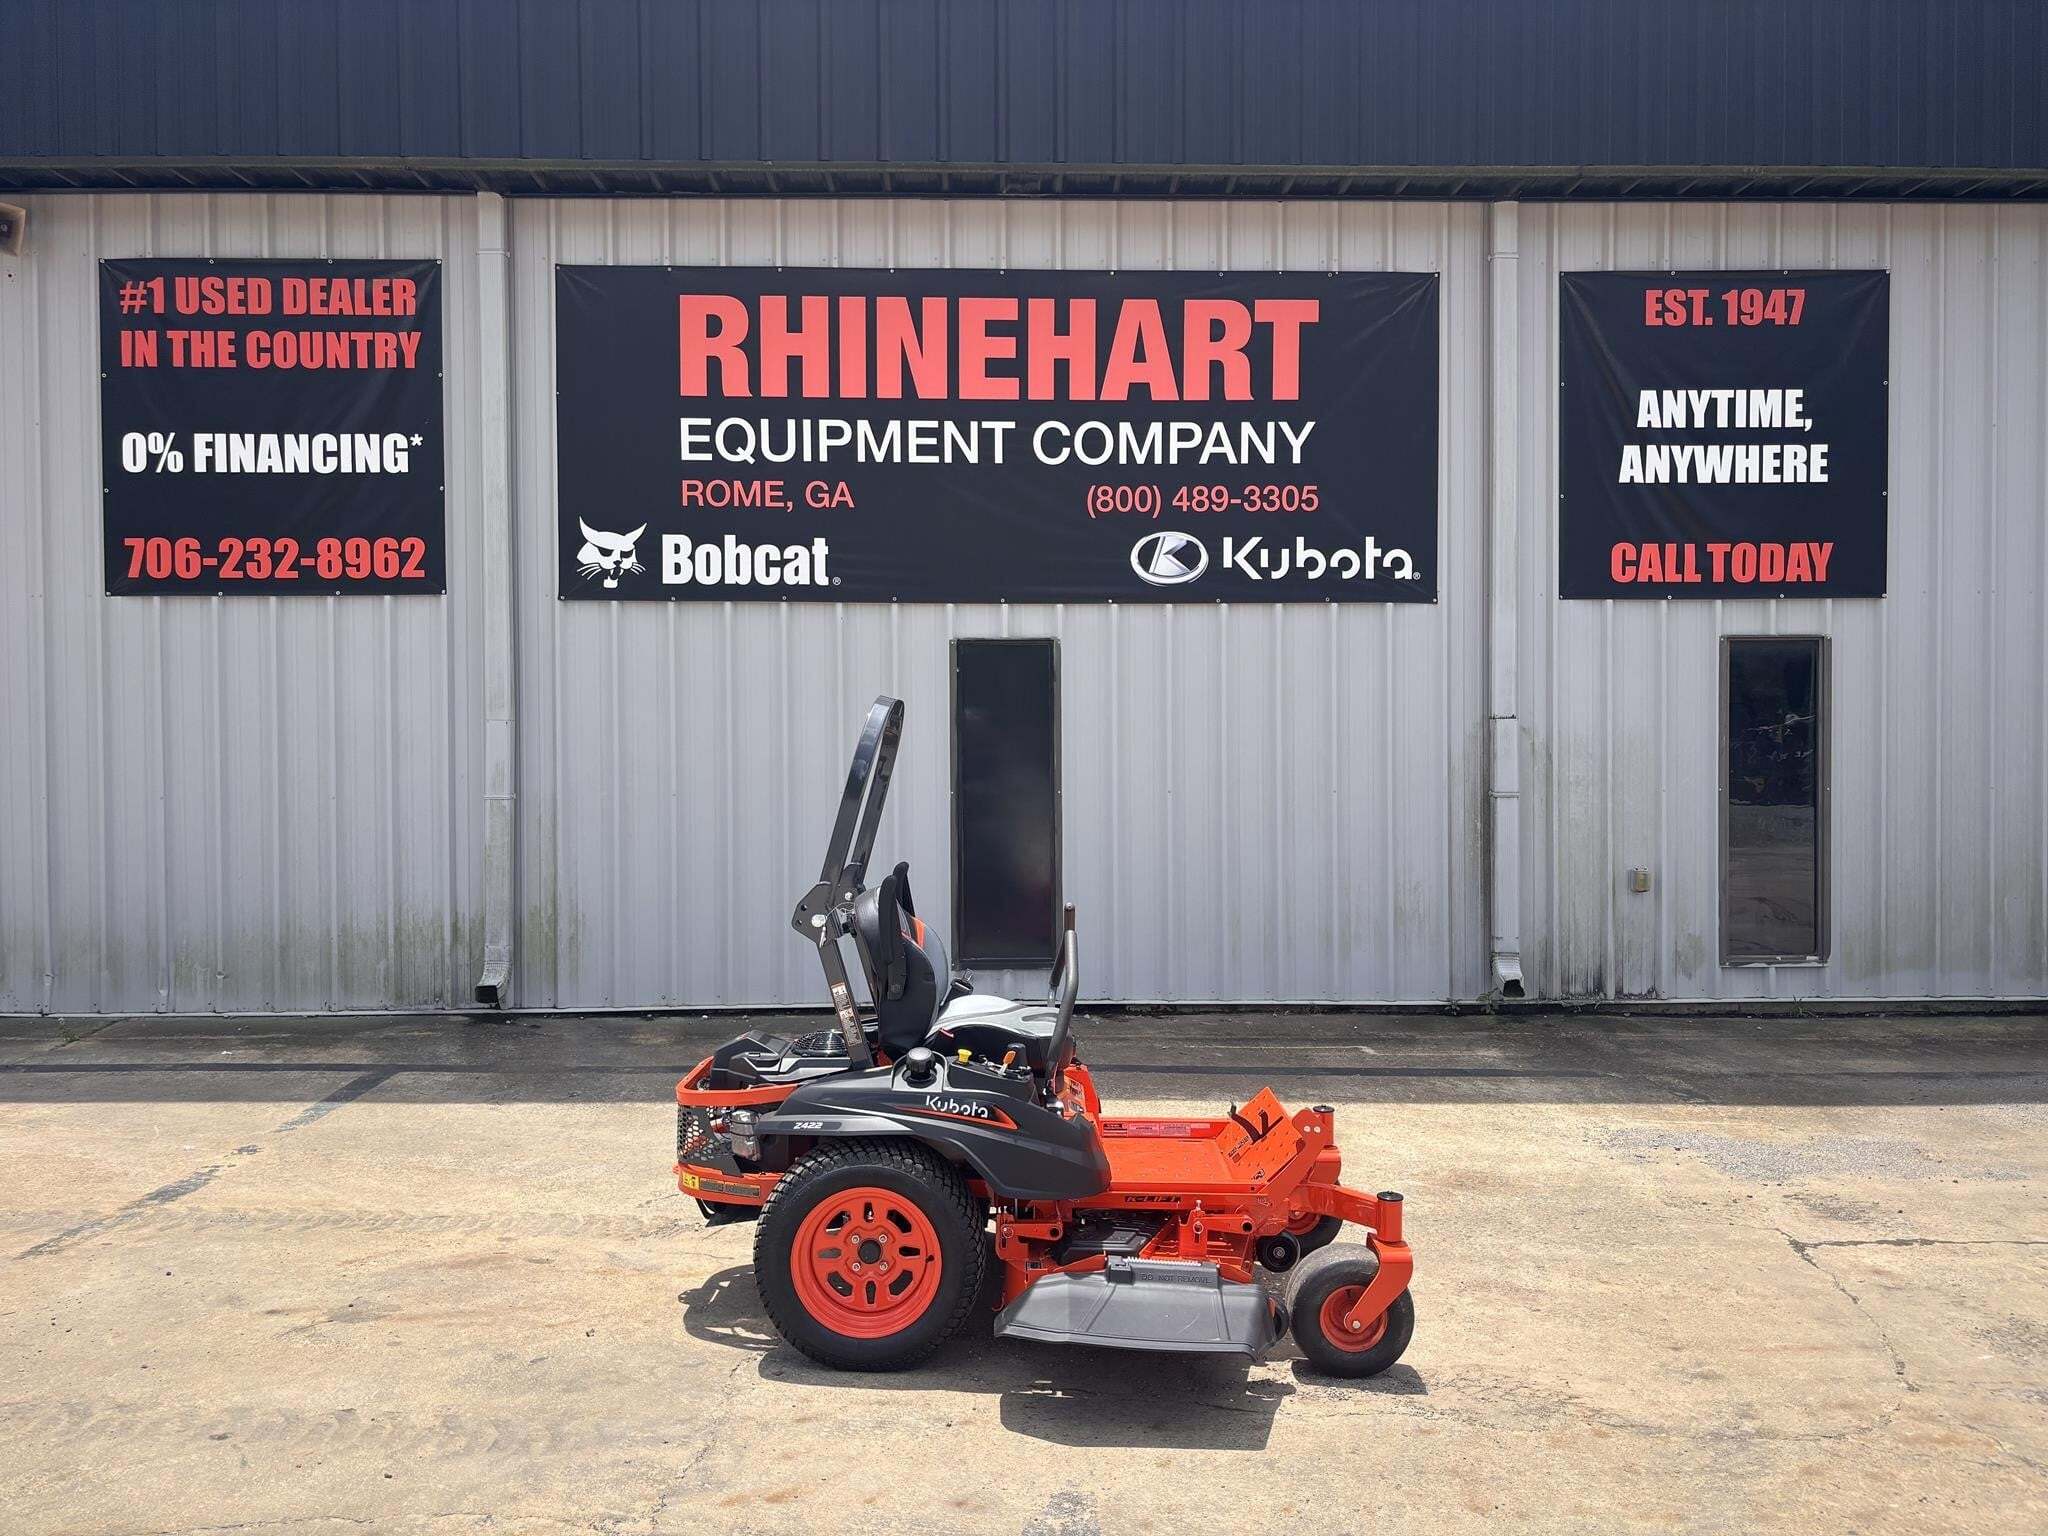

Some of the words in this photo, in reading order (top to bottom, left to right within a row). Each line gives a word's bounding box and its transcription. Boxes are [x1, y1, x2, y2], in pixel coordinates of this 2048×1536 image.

[120, 277, 165, 314] #1
[175, 277, 272, 315] USED
[283, 278, 417, 316] DEALER
[1645, 289, 1713, 326] EST.
[1722, 289, 1806, 326] 1947
[121, 330, 158, 368] IN
[167, 331, 236, 368] THE
[246, 331, 421, 369] COUNTRY
[679, 295, 1319, 401] RHINEHART
[1637, 389, 1812, 432] ANYTIME,
[122, 432, 184, 473] 0%
[680, 418, 1016, 464] EQUIPMENT
[1033, 421, 1316, 466] COMPANY
[1619, 444, 1829, 484] ANYWHERE
[682, 480, 792, 513] ROME,
[806, 481, 855, 509] GA
[1087, 485, 1162, 519] (800)
[1173, 485, 1319, 513] 489-3305
[125, 537, 426, 580] 706-232-8962
[662, 534, 829, 586] Bobcat
[1222, 536, 1413, 580] Kubota
[1610, 543, 1701, 583] CALL
[1707, 543, 1834, 583] TODAY
[793, 1121, 824, 1130] Z422
[925, 1095, 989, 1118] Kubota
[1140, 1272, 1153, 1281] DO
[1158, 1273, 1175, 1282] NOT
[1177, 1274, 1213, 1284] REMOVE
